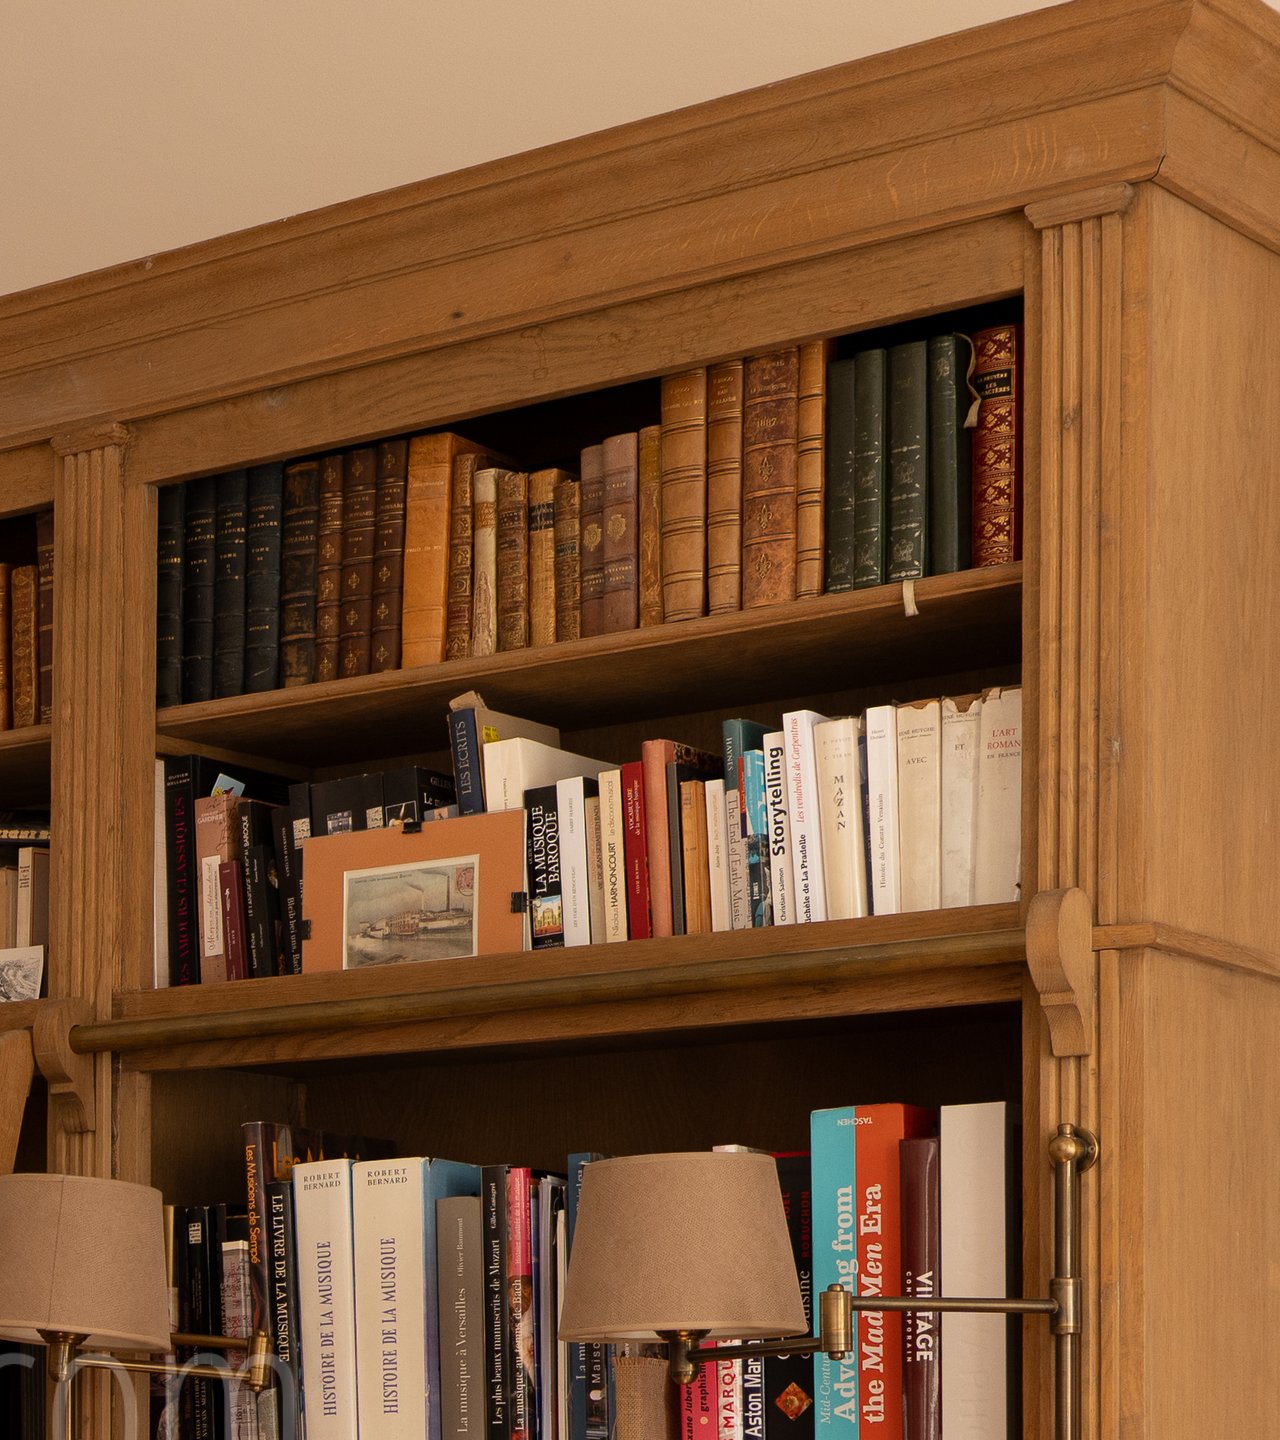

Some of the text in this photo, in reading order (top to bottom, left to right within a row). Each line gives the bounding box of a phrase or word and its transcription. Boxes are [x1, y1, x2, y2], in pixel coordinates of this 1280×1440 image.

[906, 757, 927, 765] AVEC
[987, 740, 1021, 750] ROMAN
[992, 728, 1018, 738] L'ART
[462, 769, 472, 795] LES
[767, 746, 787, 856] Storytelling
[175, 797, 190, 958] AMOURS CLASSIQUES
[532, 805, 547, 892] LA MUSIQUE
[546, 811, 560, 882] BAROQUE
[606, 841, 619, 907] HARNONCOURT
[728, 796, 742, 922] The End Music
[800, 834, 809, 892] de La Pradelle
[303, 1172, 340, 1182] ROBERT
[303, 1181, 341, 1190] BERNARD
[367, 1168, 407, 1178] ROBERT
[367, 1176, 408, 1186] BERNARD
[832, 1185, 853, 1252] from
[272, 1195, 289, 1362] LE LIVRE DE LA MUSIQUE
[860, 1184, 885, 1424] the Mad Men Era
[316, 1241, 337, 1416] HISTOIRE DE LA MUSIQUE
[380, 1238, 399, 1414] HISTOIRE DE LA MUSIQUE
[454, 1287, 471, 1432] La musique Versailles
[489, 1239, 506, 1425] Les plus beaux manuscrits de Mozart
[512, 1279, 526, 1431] La musique au Bach
[745, 1393, 762, 1437] Aston
